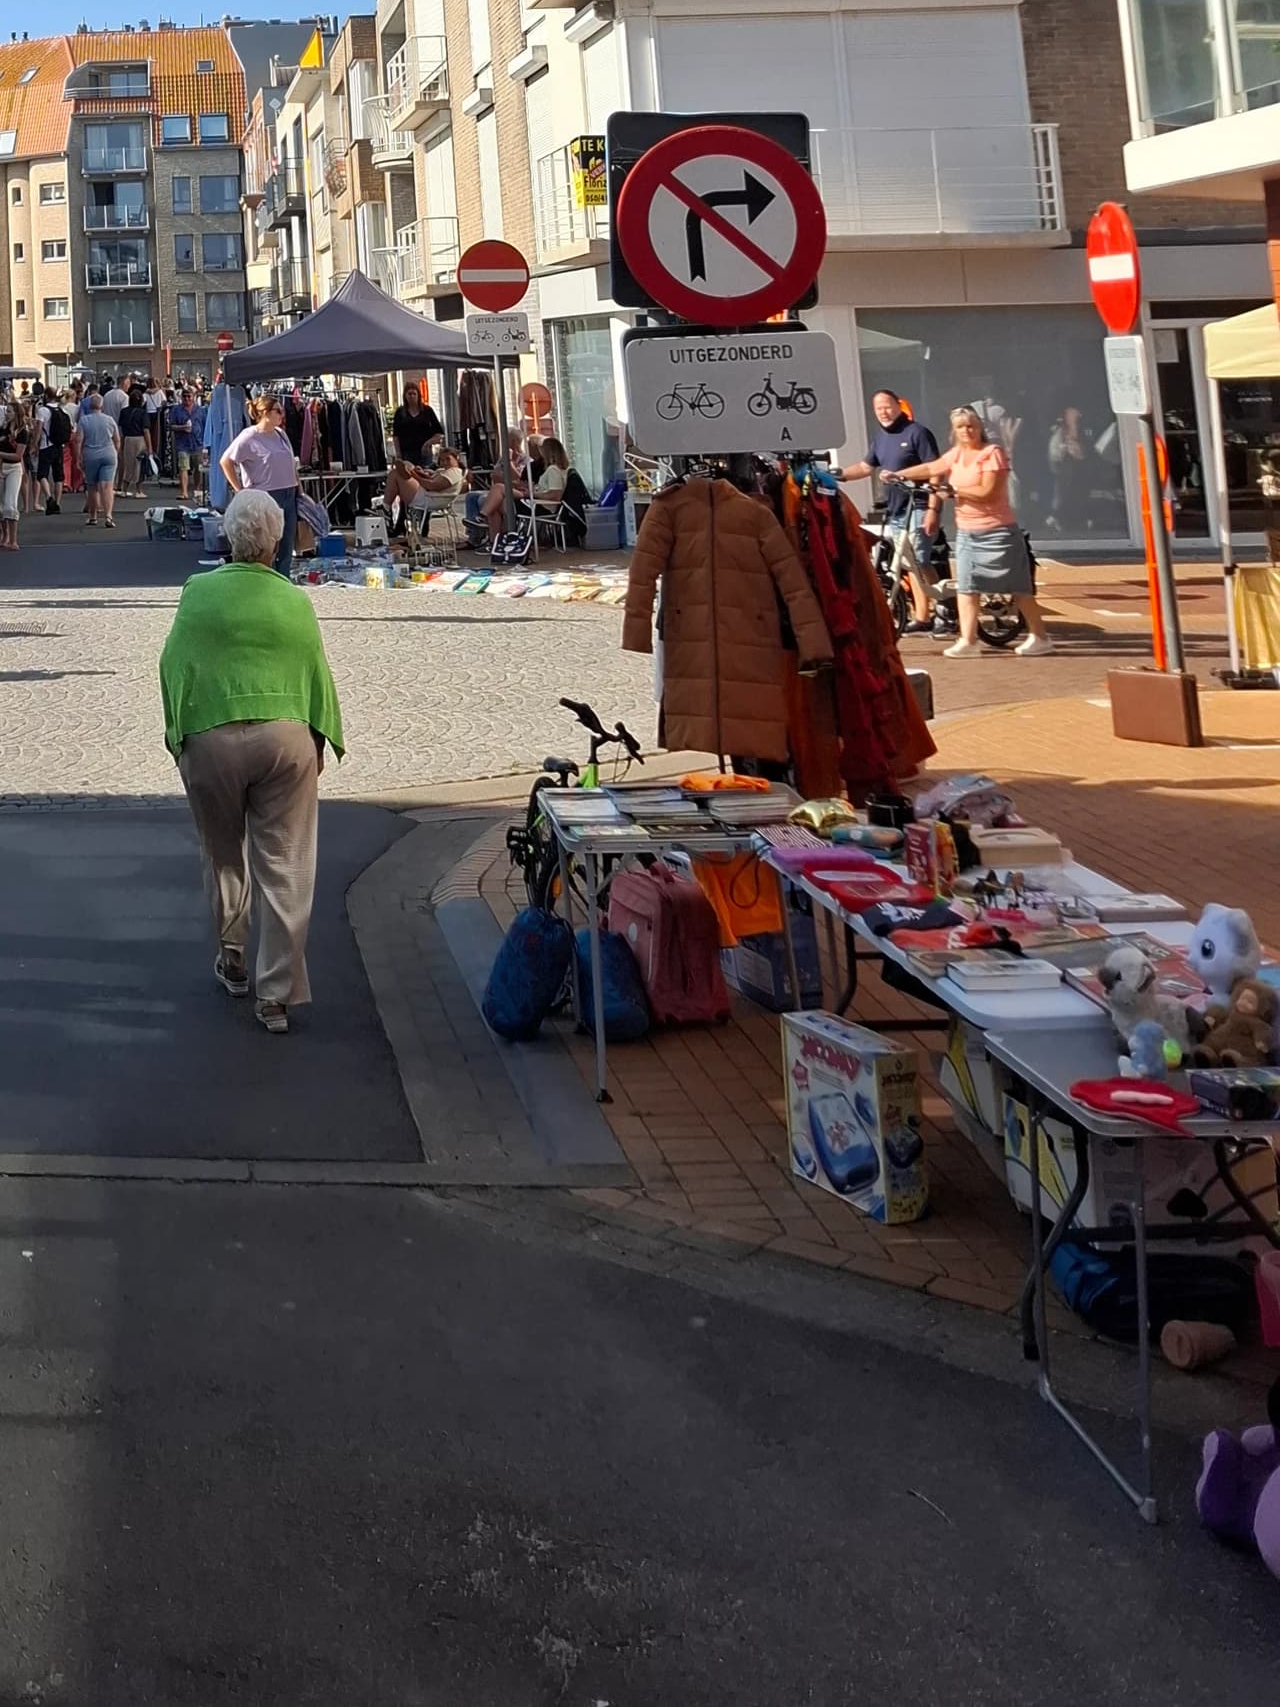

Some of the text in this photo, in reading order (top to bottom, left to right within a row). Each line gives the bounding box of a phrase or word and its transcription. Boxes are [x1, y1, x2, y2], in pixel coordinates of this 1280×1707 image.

[581, 139, 605, 152] TE K
[670, 344, 793, 364] UITGEZONDERD
[781, 427, 792, 441] A
